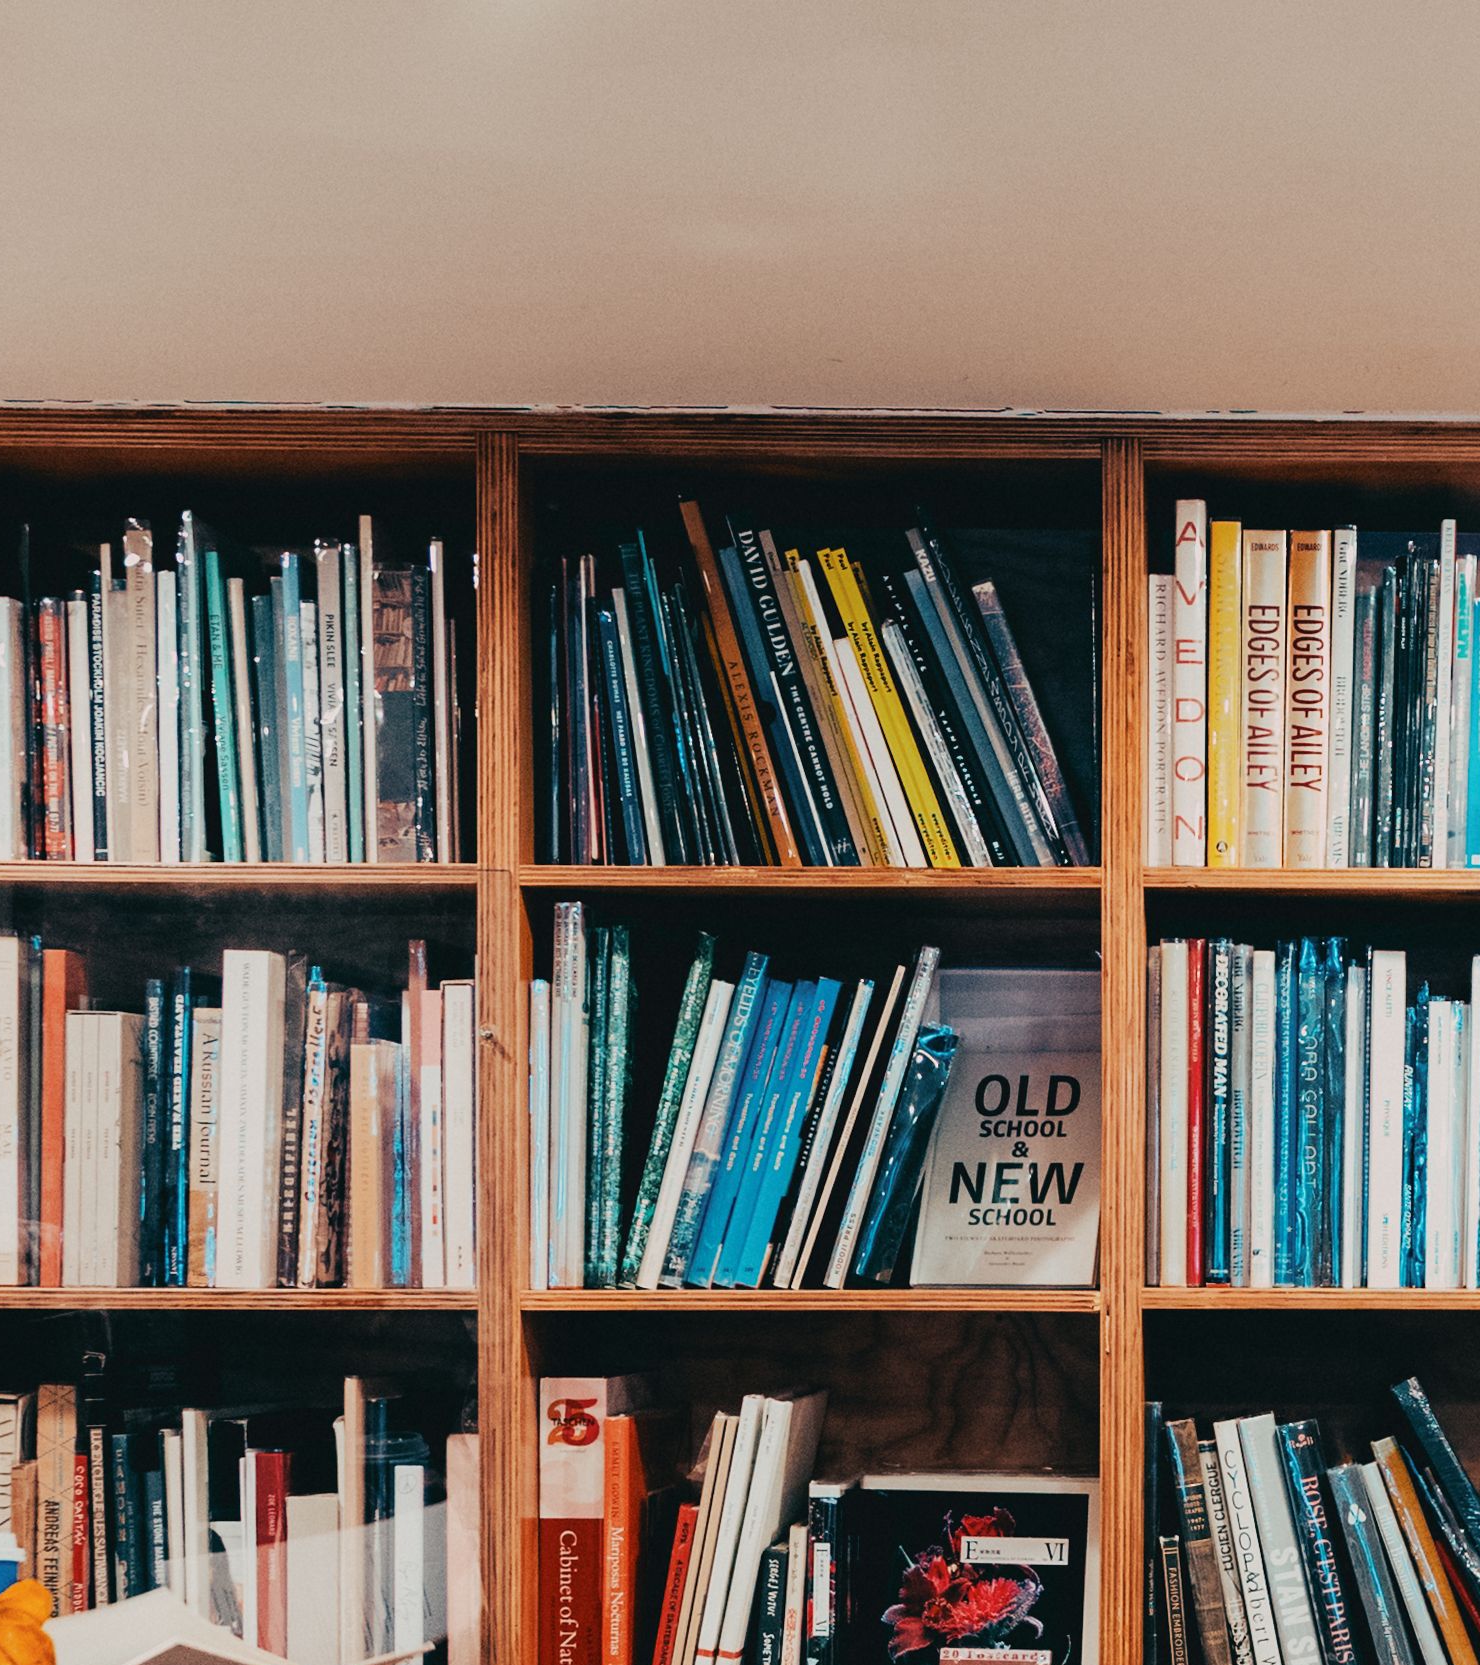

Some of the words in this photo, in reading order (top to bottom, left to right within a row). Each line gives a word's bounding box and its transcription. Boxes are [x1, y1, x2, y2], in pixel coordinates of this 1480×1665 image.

[915, 549, 937, 582] KAZU
[91, 594, 103, 641] PARADISE
[325, 614, 336, 636] PIKIN
[737, 530, 772, 589] DAVID
[757, 595, 797, 677] GULDEN
[1155, 584, 1167, 661] RICHARD
[326, 639, 336, 668] SLEE
[1247, 605, 1280, 682] EDGES
[1291, 605, 1324, 682] EDGES
[787, 685, 802, 706] THE
[1155, 668, 1166, 736] AVEDON
[1247, 689, 1279, 717] OF
[1292, 689, 1323, 717] OF
[93, 705, 105, 740] JOAKIM
[728, 660, 752, 723] ALEXIS
[747, 732, 780, 818] ROCKMAN
[794, 709, 811, 743] CENTRE
[803, 745, 822, 780] CANNOT
[1246, 725, 1279, 793] AILEY
[1290, 725, 1322, 793] AILEY
[817, 784, 833, 810] HOLD
[201, 1033, 217, 1046] A
[199, 1050, 216, 1114] Russian
[706, 1054, 739, 1136] MORNING
[975, 1075, 1082, 1117] OLD
[1213, 1059, 1227, 1098] MAN
[197, 1120, 216, 1185] Journal
[979, 1120, 1068, 1137] SCHOOL
[1013, 1142, 1029, 1158] &
[949, 1162, 1084, 1205] NEW
[967, 1209, 1056, 1226] SCHOOL
[1207, 1463, 1228, 1522] CLERGUE
[1299, 1476, 1327, 1539] ROSE,
[43, 1500, 60, 1553] ANDREAS
[1216, 1523, 1234, 1571] LUCIEN
[558, 1530, 578, 1595] Cabinet
[607, 1526, 624, 1589] Mariposas
[1311, 1544, 1338, 1599] C'EST
[1168, 1567, 1182, 1609] FASHION
[1269, 1546, 1310, 1631] STAN
[558, 1600, 577, 1627] of
[609, 1591, 624, 1655] Nocturnas
[1327, 1603, 1355, 1664] PARIS
